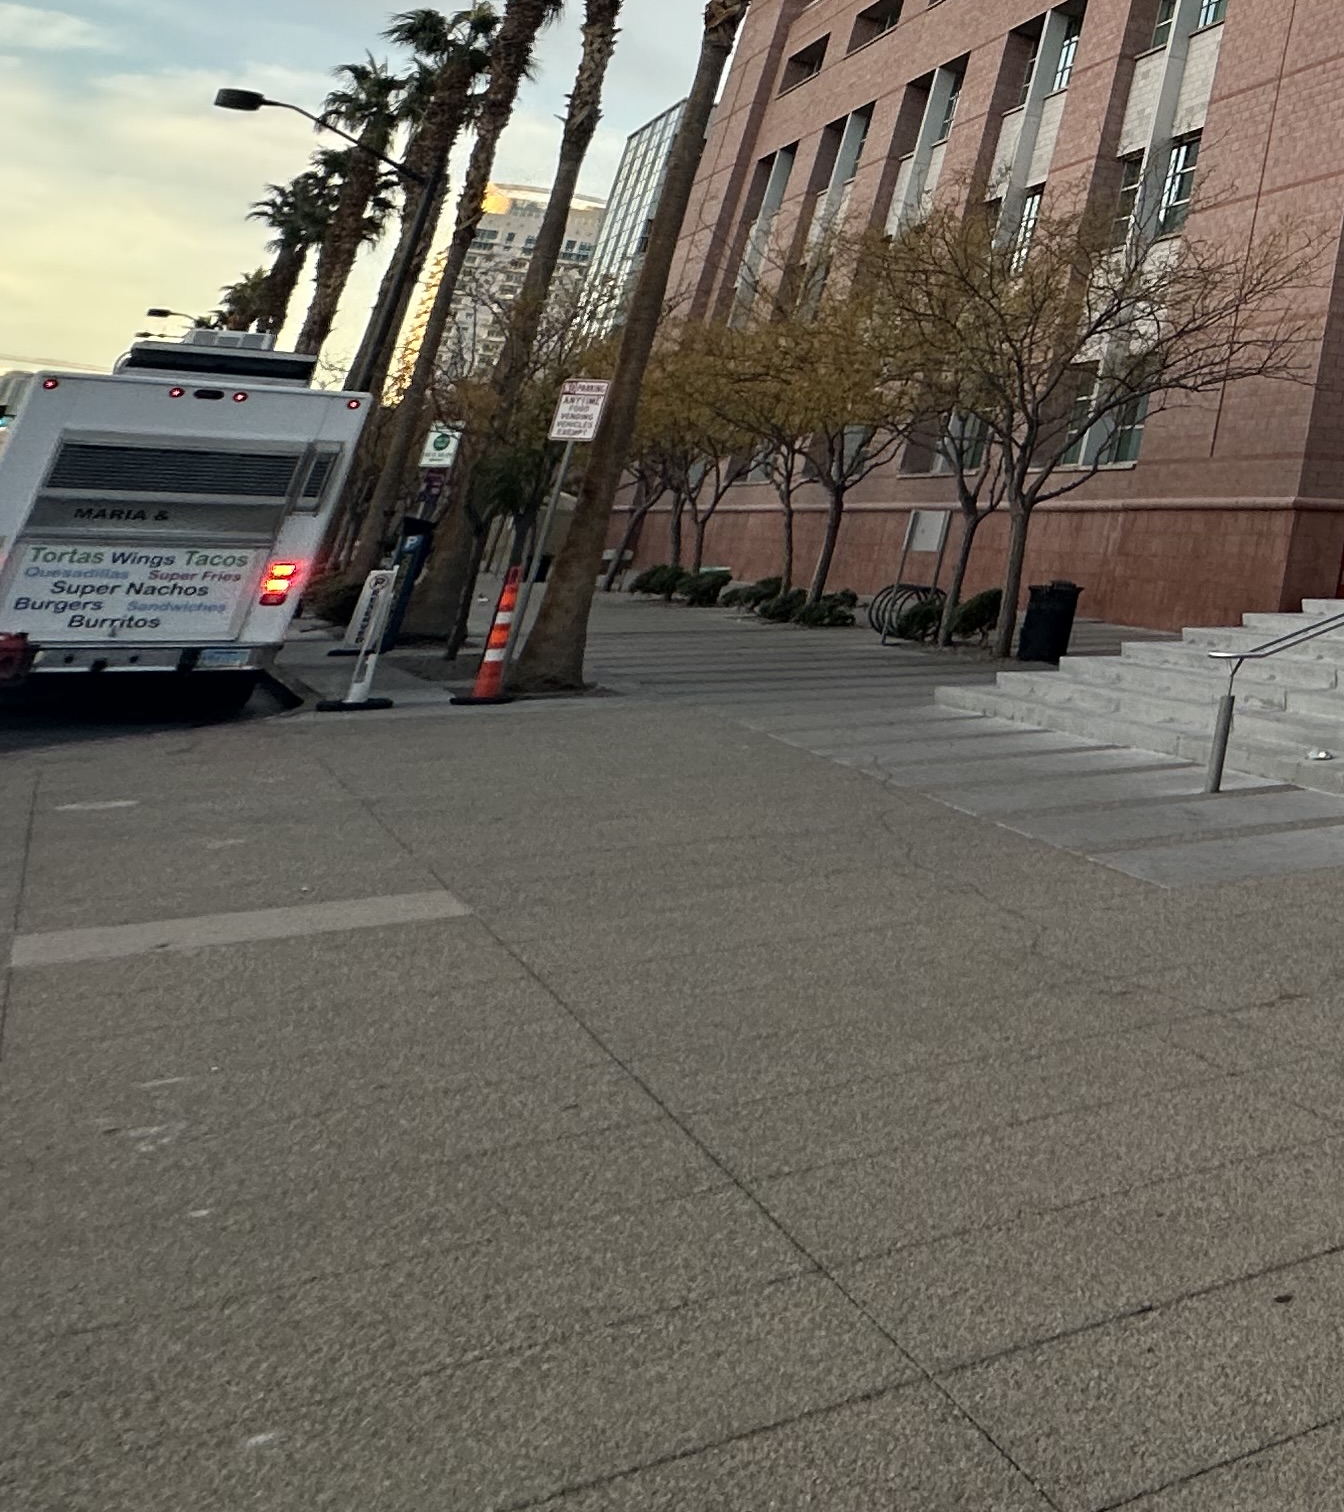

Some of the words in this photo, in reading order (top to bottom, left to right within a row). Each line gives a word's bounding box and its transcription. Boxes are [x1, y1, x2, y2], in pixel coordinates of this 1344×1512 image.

[75, 508, 146, 521] MARIA
[154, 510, 169, 521] &
[31, 547, 104, 564] Tortas
[112, 552, 176, 568] Wings
[184, 551, 249, 567] Tacos
[25, 566, 128, 580] Quesadillas
[148, 570, 197, 582] Super
[201, 571, 242, 582] Fries
[51, 581, 121, 597] Super
[126, 582, 209, 597] Nachos
[14, 597, 103, 613] Burgers
[127, 601, 226, 613] Sandwiches
[67, 615, 161, 629] Burritos
